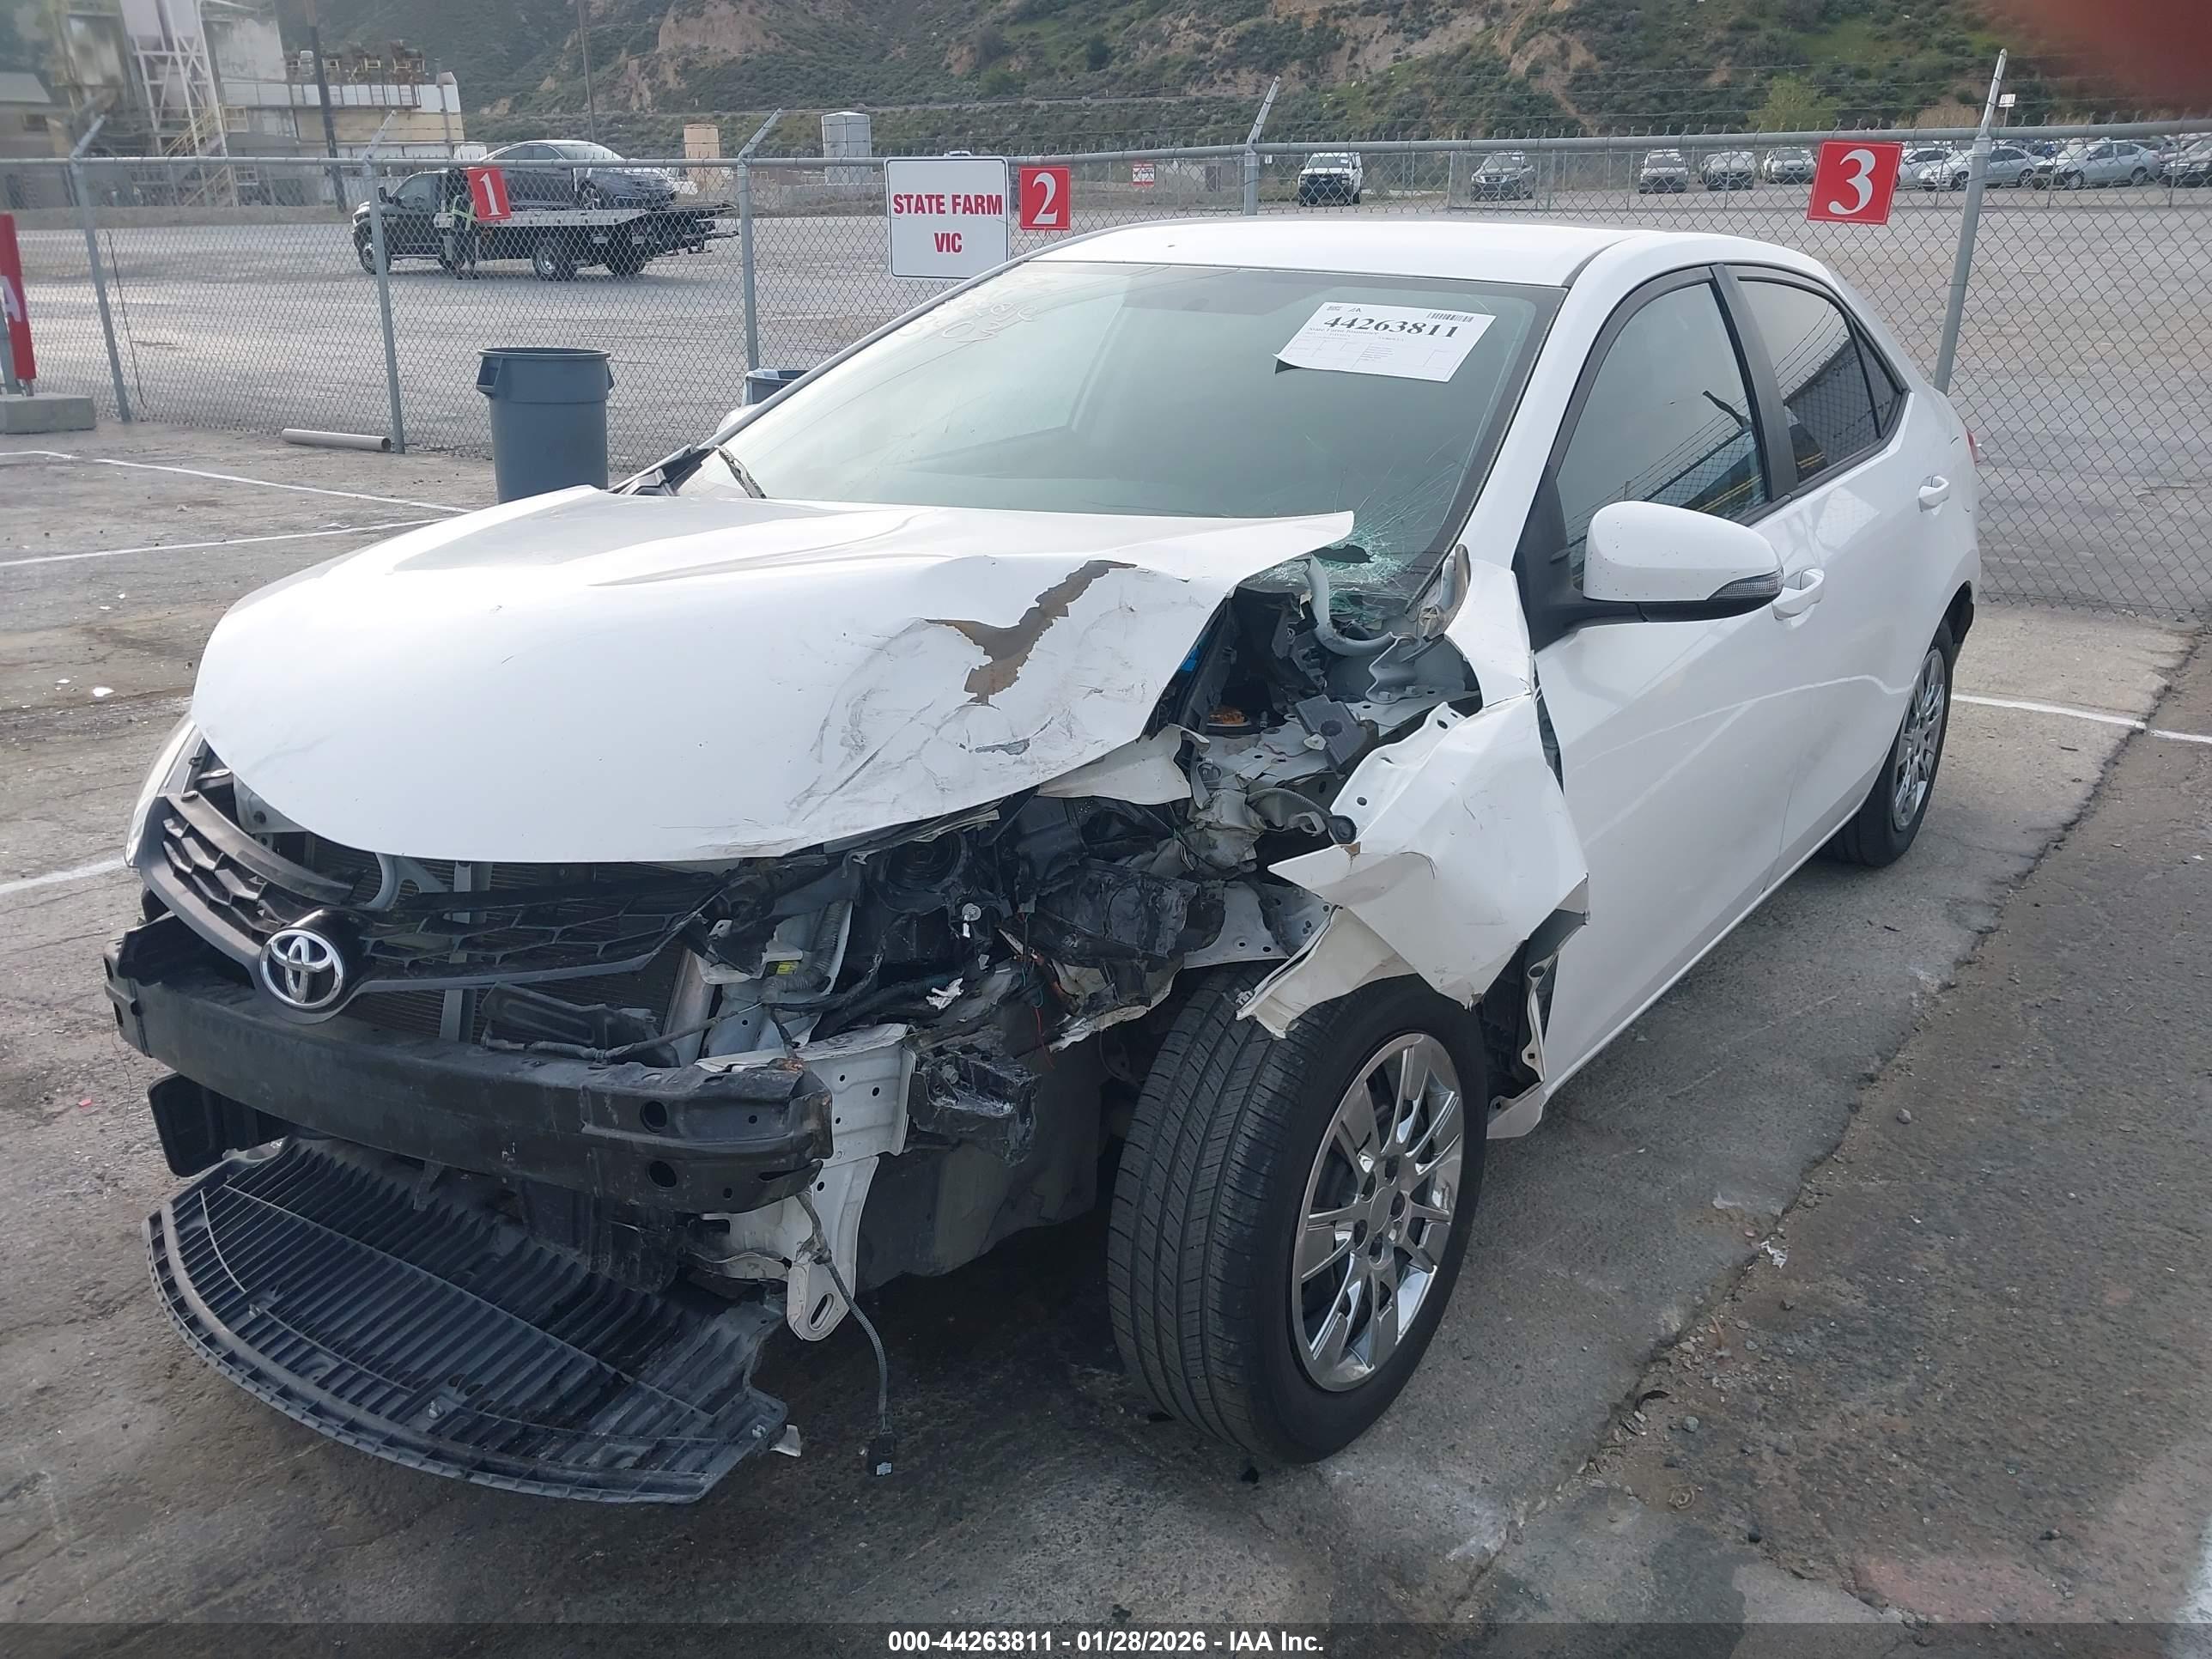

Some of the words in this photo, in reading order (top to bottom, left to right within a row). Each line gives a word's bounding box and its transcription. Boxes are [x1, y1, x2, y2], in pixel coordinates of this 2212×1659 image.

[479, 172, 502, 216] 1
[1032, 171, 1059, 225] 2
[1827, 149, 1876, 215] 3
[893, 193, 946, 215] STATE
[951, 194, 1003, 215] FARM
[933, 232, 963, 253] VIC
[1323, 315, 1459, 338] 44263811
